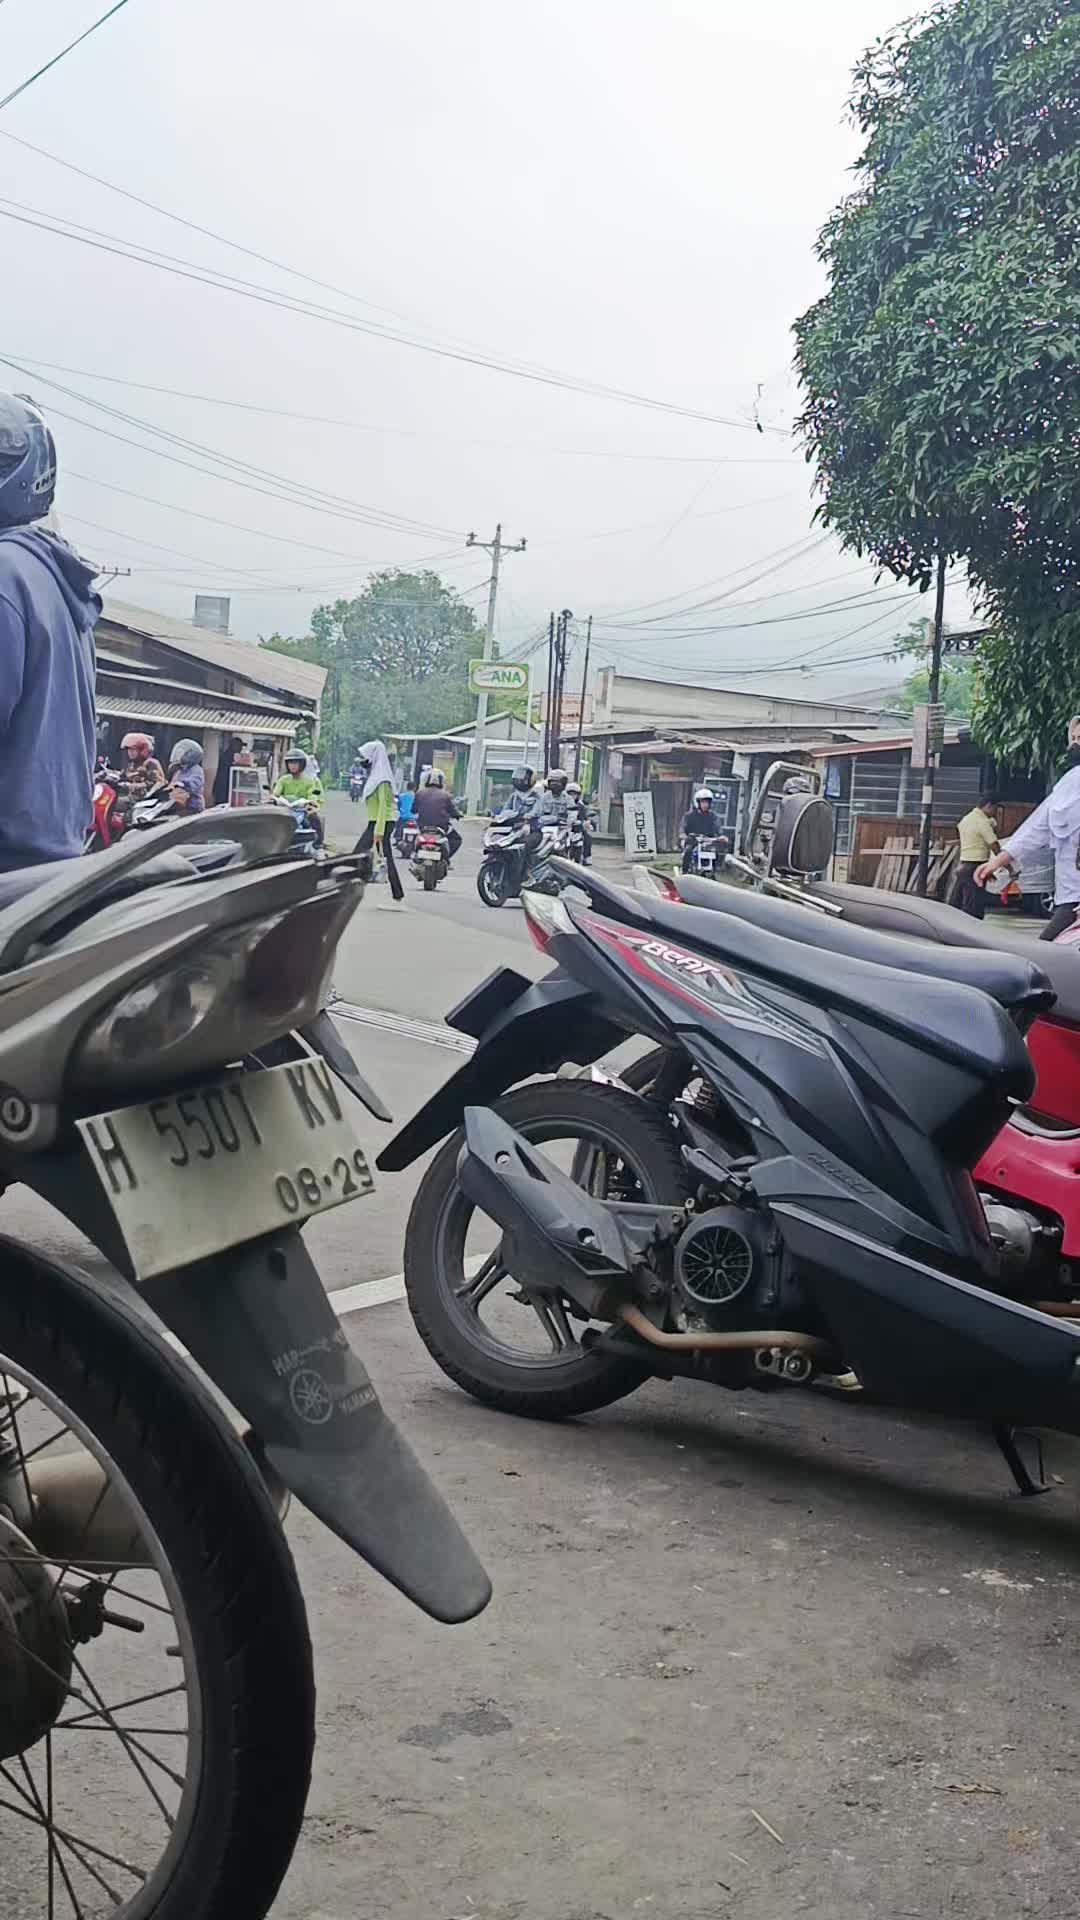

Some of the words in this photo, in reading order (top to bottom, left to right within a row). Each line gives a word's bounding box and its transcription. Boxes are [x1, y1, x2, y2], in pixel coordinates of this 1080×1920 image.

[634, 811, 648, 850] MOTOR
[85, 1115, 138, 1194] H
[146, 1082, 264, 1168] 5501
[284, 1061, 343, 1130] KV
